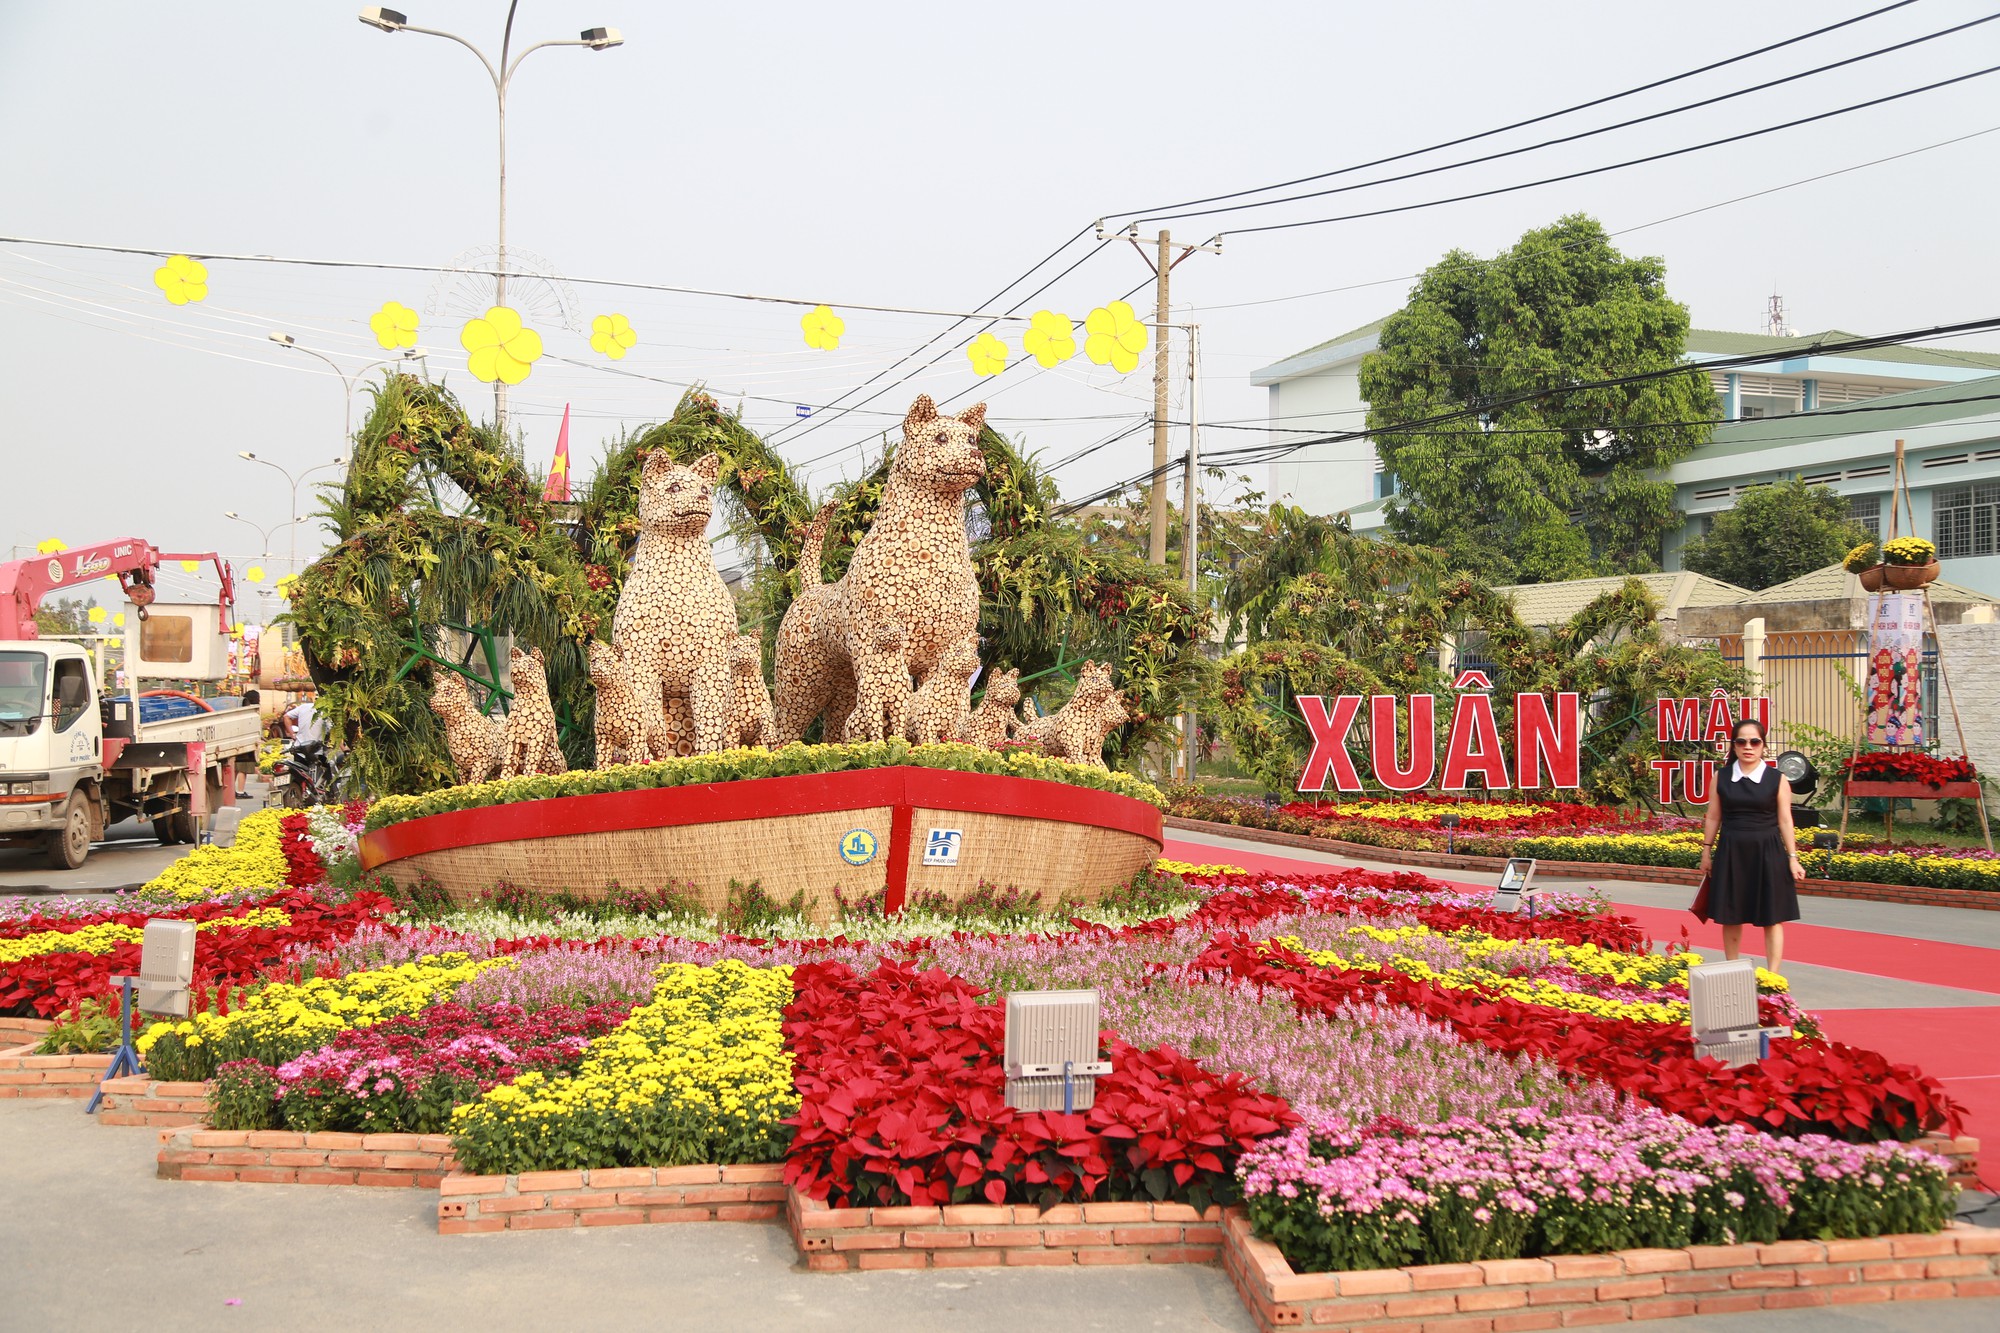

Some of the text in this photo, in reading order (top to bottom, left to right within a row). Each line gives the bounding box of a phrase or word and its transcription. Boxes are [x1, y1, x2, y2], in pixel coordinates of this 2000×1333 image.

[113, 544, 132, 559] UNIC
[1295, 670, 1580, 792] XUÂN
[1657, 687, 1770, 753] MẬU
